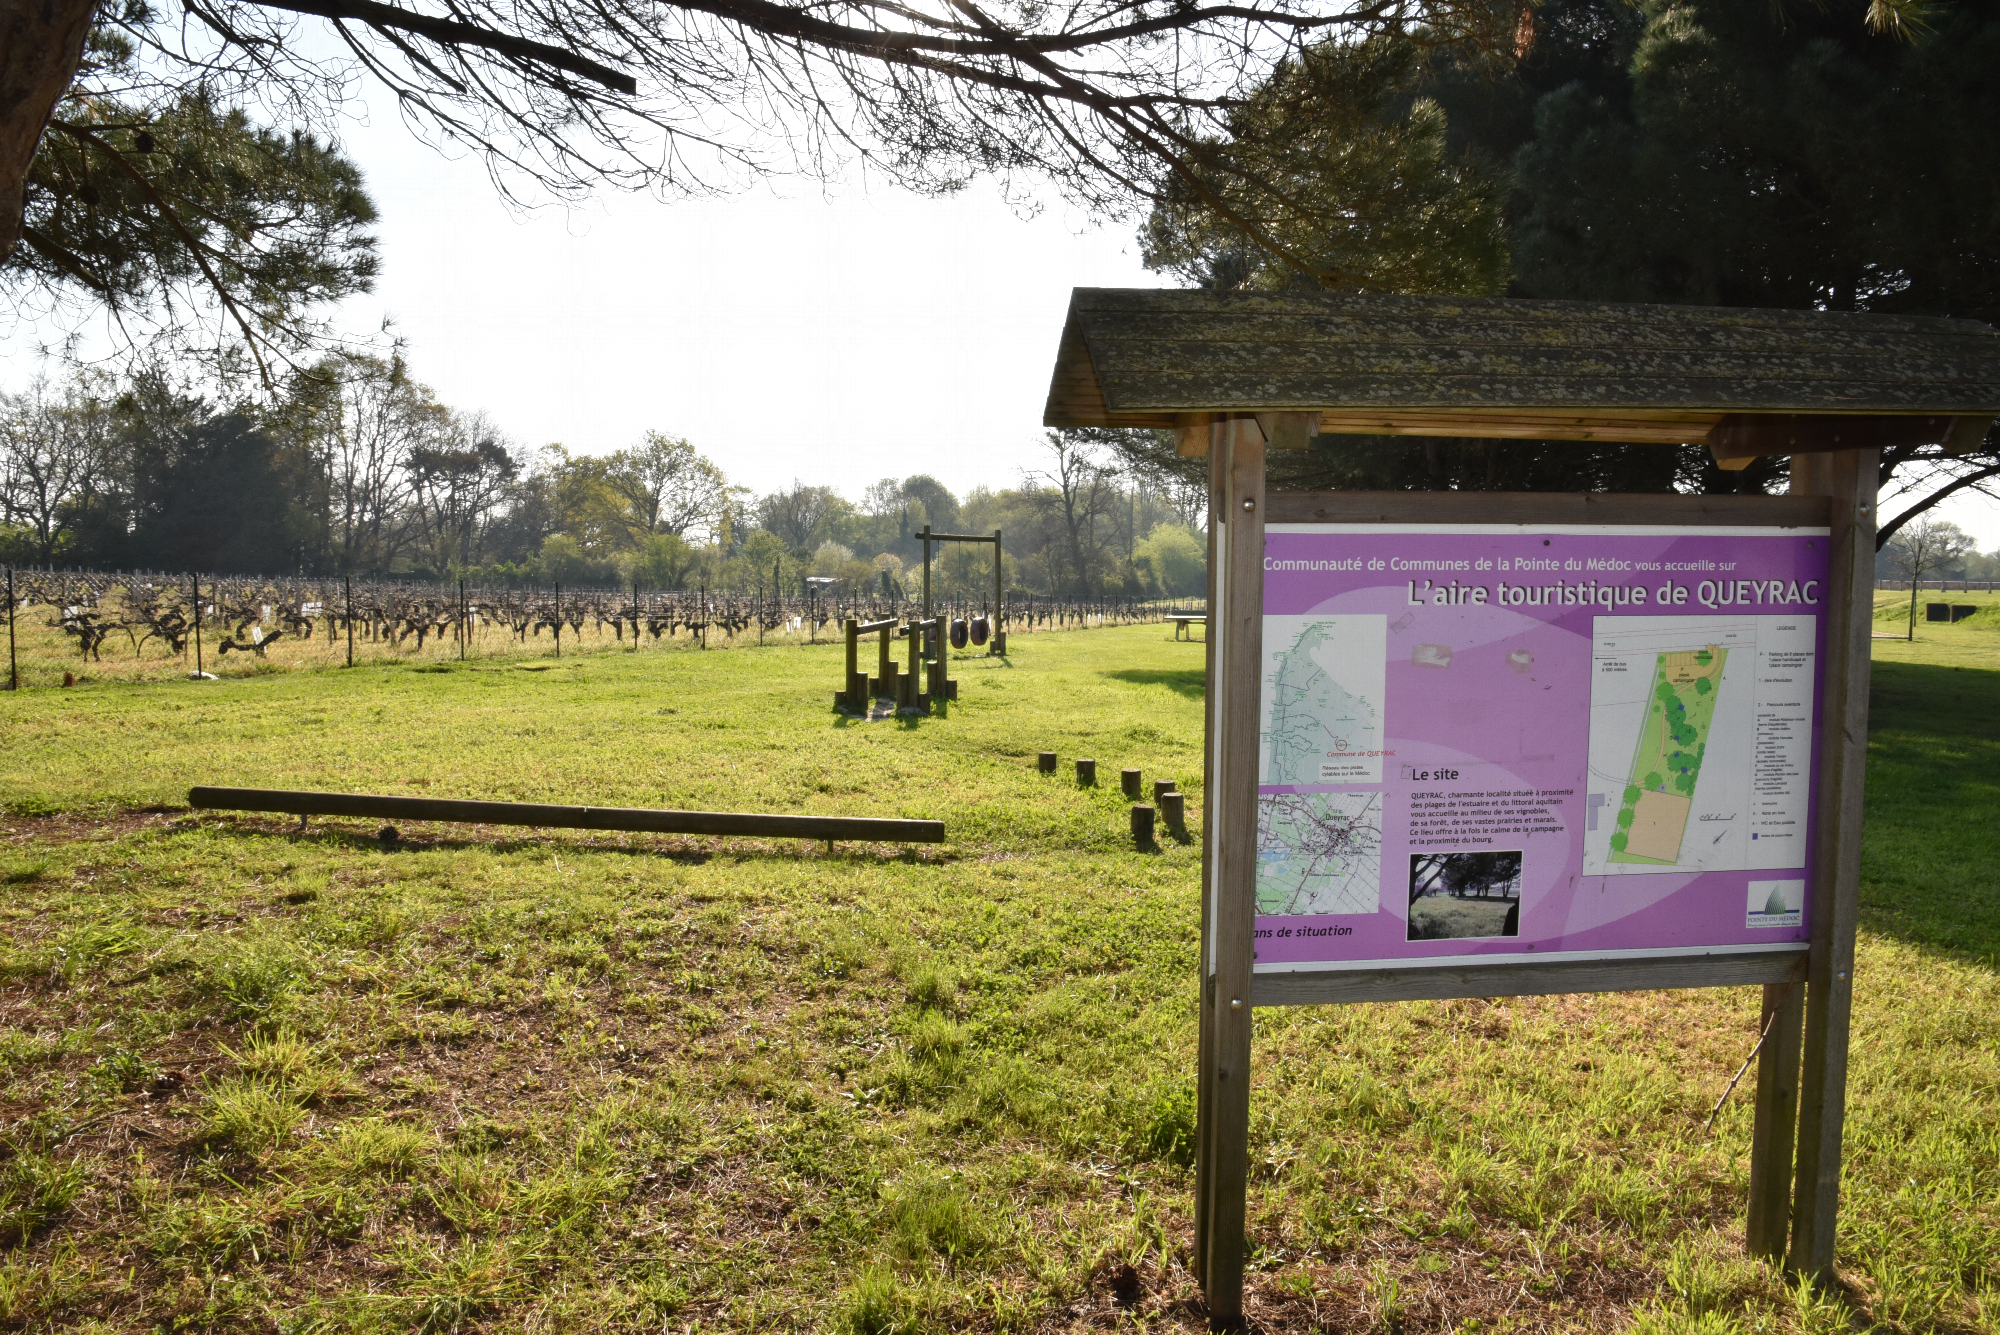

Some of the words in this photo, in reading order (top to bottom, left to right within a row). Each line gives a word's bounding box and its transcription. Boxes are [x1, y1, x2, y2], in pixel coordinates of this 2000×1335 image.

[1263, 557, 1363, 571] Communauté
[1367, 557, 1386, 571] de
[1390, 557, 1470, 571] Communes
[1474, 557, 1493, 571] de
[1497, 557, 1510, 571] la
[1514, 557, 1560, 571] Pointe
[1564, 558, 1582, 571] du
[1586, 558, 1631, 571] Médoc
[1634, 561, 1661, 571] vous
[1664, 560, 1716, 571] accueille
[1719, 561, 1737, 571] sur
[1407, 579, 1488, 605] L'aire
[1497, 579, 1648, 611] touristique
[1656, 580, 1690, 605] de
[1697, 579, 1819, 609] QUEYRAC
[1412, 768, 1429, 780] Le
[1433, 768, 1459, 780] site
[1411, 792, 1446, 800] QUEYRAC,
[1448, 790, 1484, 798] charmante
[1542, 788, 1574, 798] proximité
[1424, 801, 1446, 810] plages
[1536, 798, 1563, 806] aquitain
[1325, 813, 1350, 822] Queyrac
[1516, 808, 1550, 816] vignobles,
[1430, 819, 1449, 827] forêt,
[1426, 837, 1460, 845] proximité
[1472, 836, 1494, 844] bourg.
[1253, 929, 1273, 938] ans
[1277, 927, 1292, 938] de
[1296, 925, 1352, 937] situation
